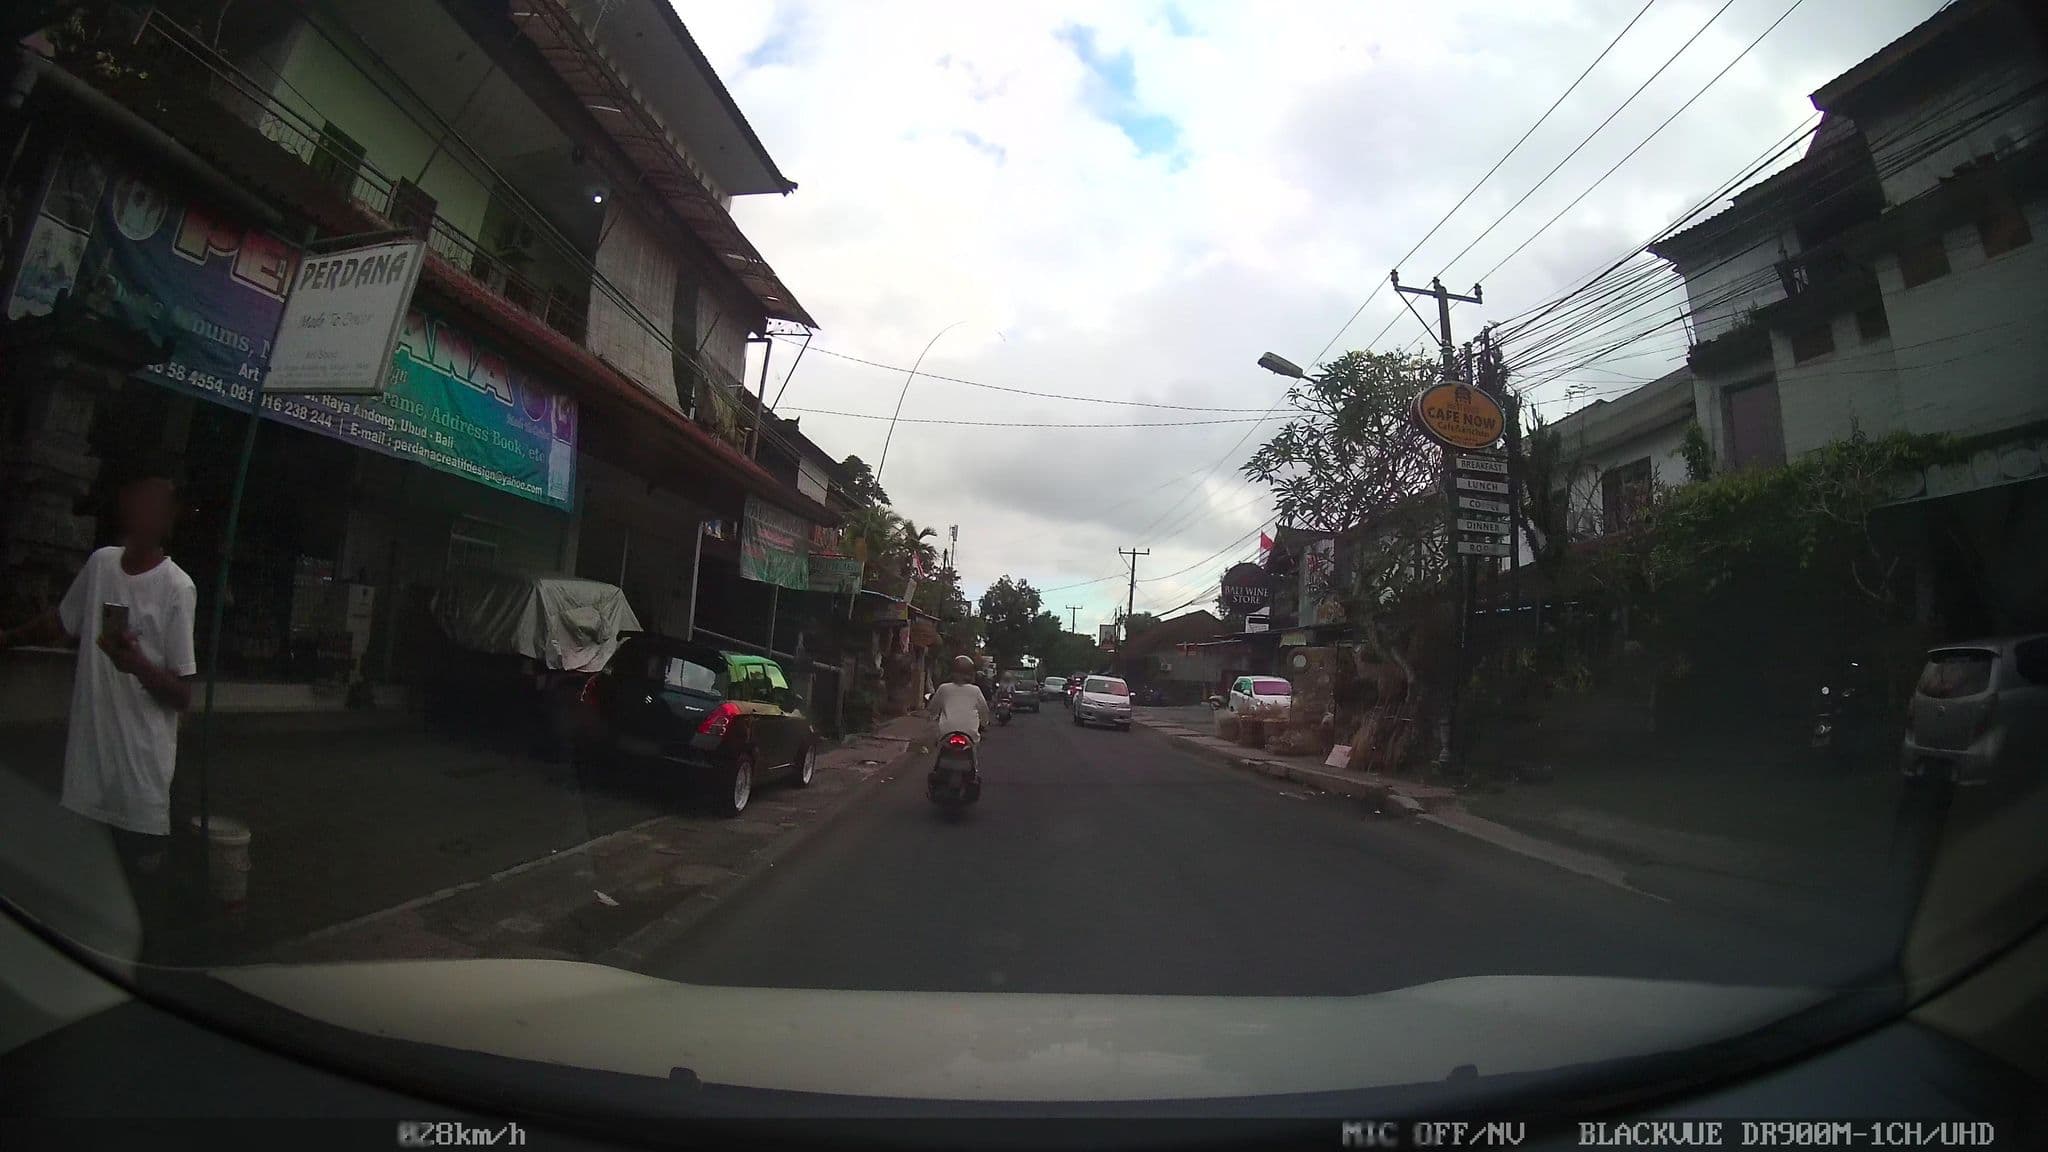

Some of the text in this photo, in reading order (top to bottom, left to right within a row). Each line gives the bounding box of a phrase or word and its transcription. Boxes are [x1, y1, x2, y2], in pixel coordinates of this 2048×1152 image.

[299, 252, 407, 291] PERDANA
[238, 362, 260, 382] Art
[284, 400, 309, 420] 238
[310, 410, 333, 428] 244
[350, 422, 386, 444] E-mail
[322, 394, 350, 414] Raya
[353, 403, 398, 432] Andong,
[400, 419, 428, 439] Ubud
[436, 430, 455, 450] Bali
[1427, 407, 1460, 422] CAFE
[1463, 414, 1496, 428] NOW
[431, 405, 490, 441] Address
[493, 430, 526, 457] Book,
[1461, 460, 1502, 471] BREAKFAST
[1468, 481, 1498, 490] LUNCH
[1466, 521, 1500, 532] DINNER
[1224, 585, 1269, 597] BALI WINE
[1232, 595, 1261, 604] STORE
